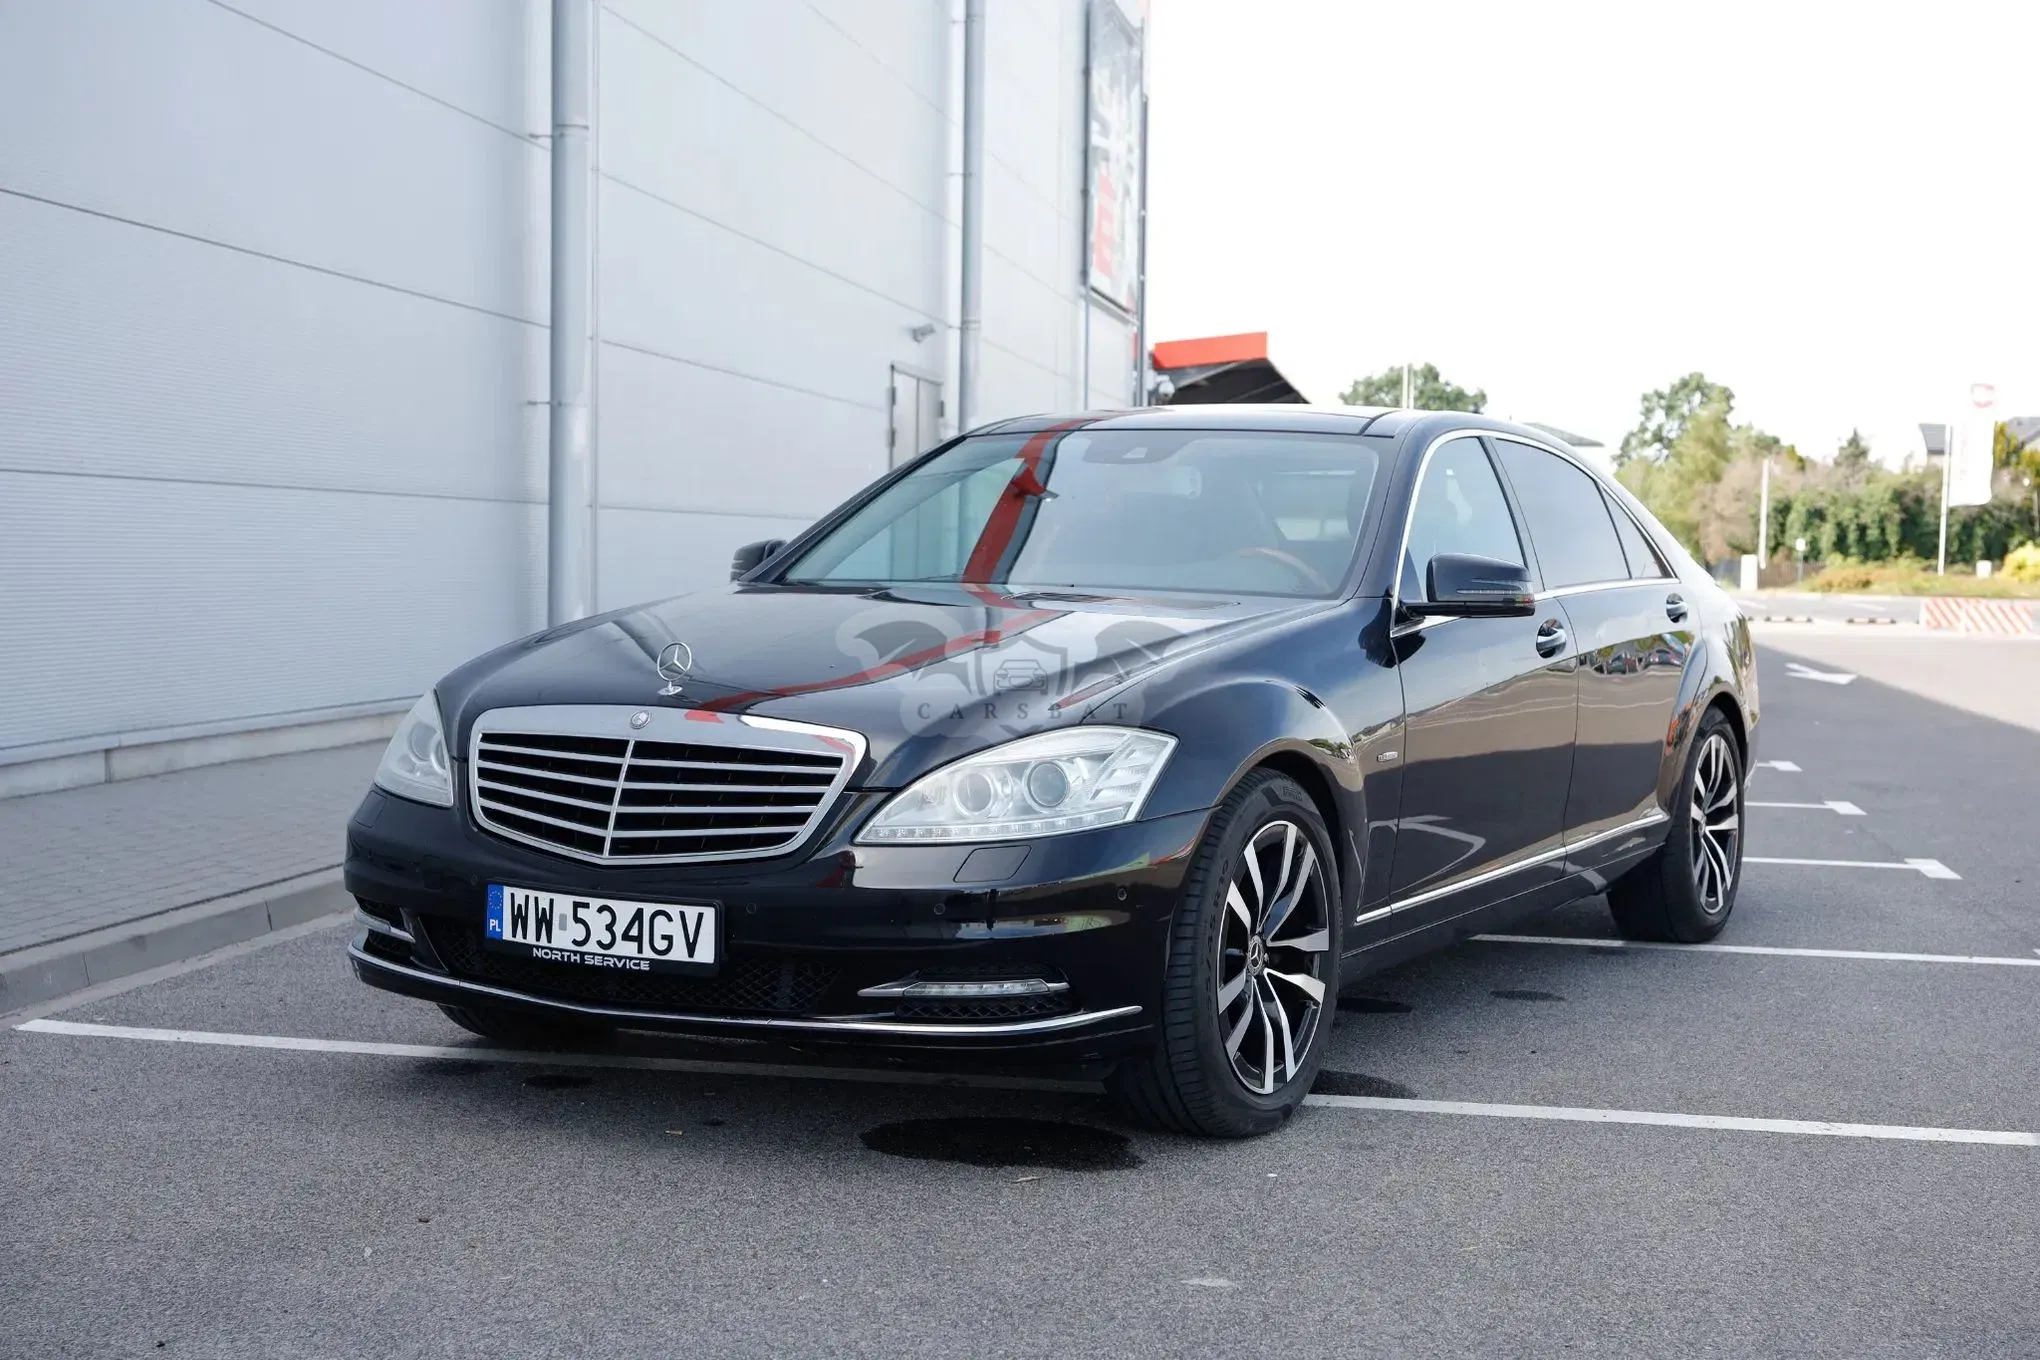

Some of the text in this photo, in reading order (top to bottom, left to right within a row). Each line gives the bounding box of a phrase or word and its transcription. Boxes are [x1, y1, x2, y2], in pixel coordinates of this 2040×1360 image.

[489, 918, 502, 932] PL
[510, 892, 704, 958] WW 534GV
[532, 947, 650, 971] NORTH SERVICE
